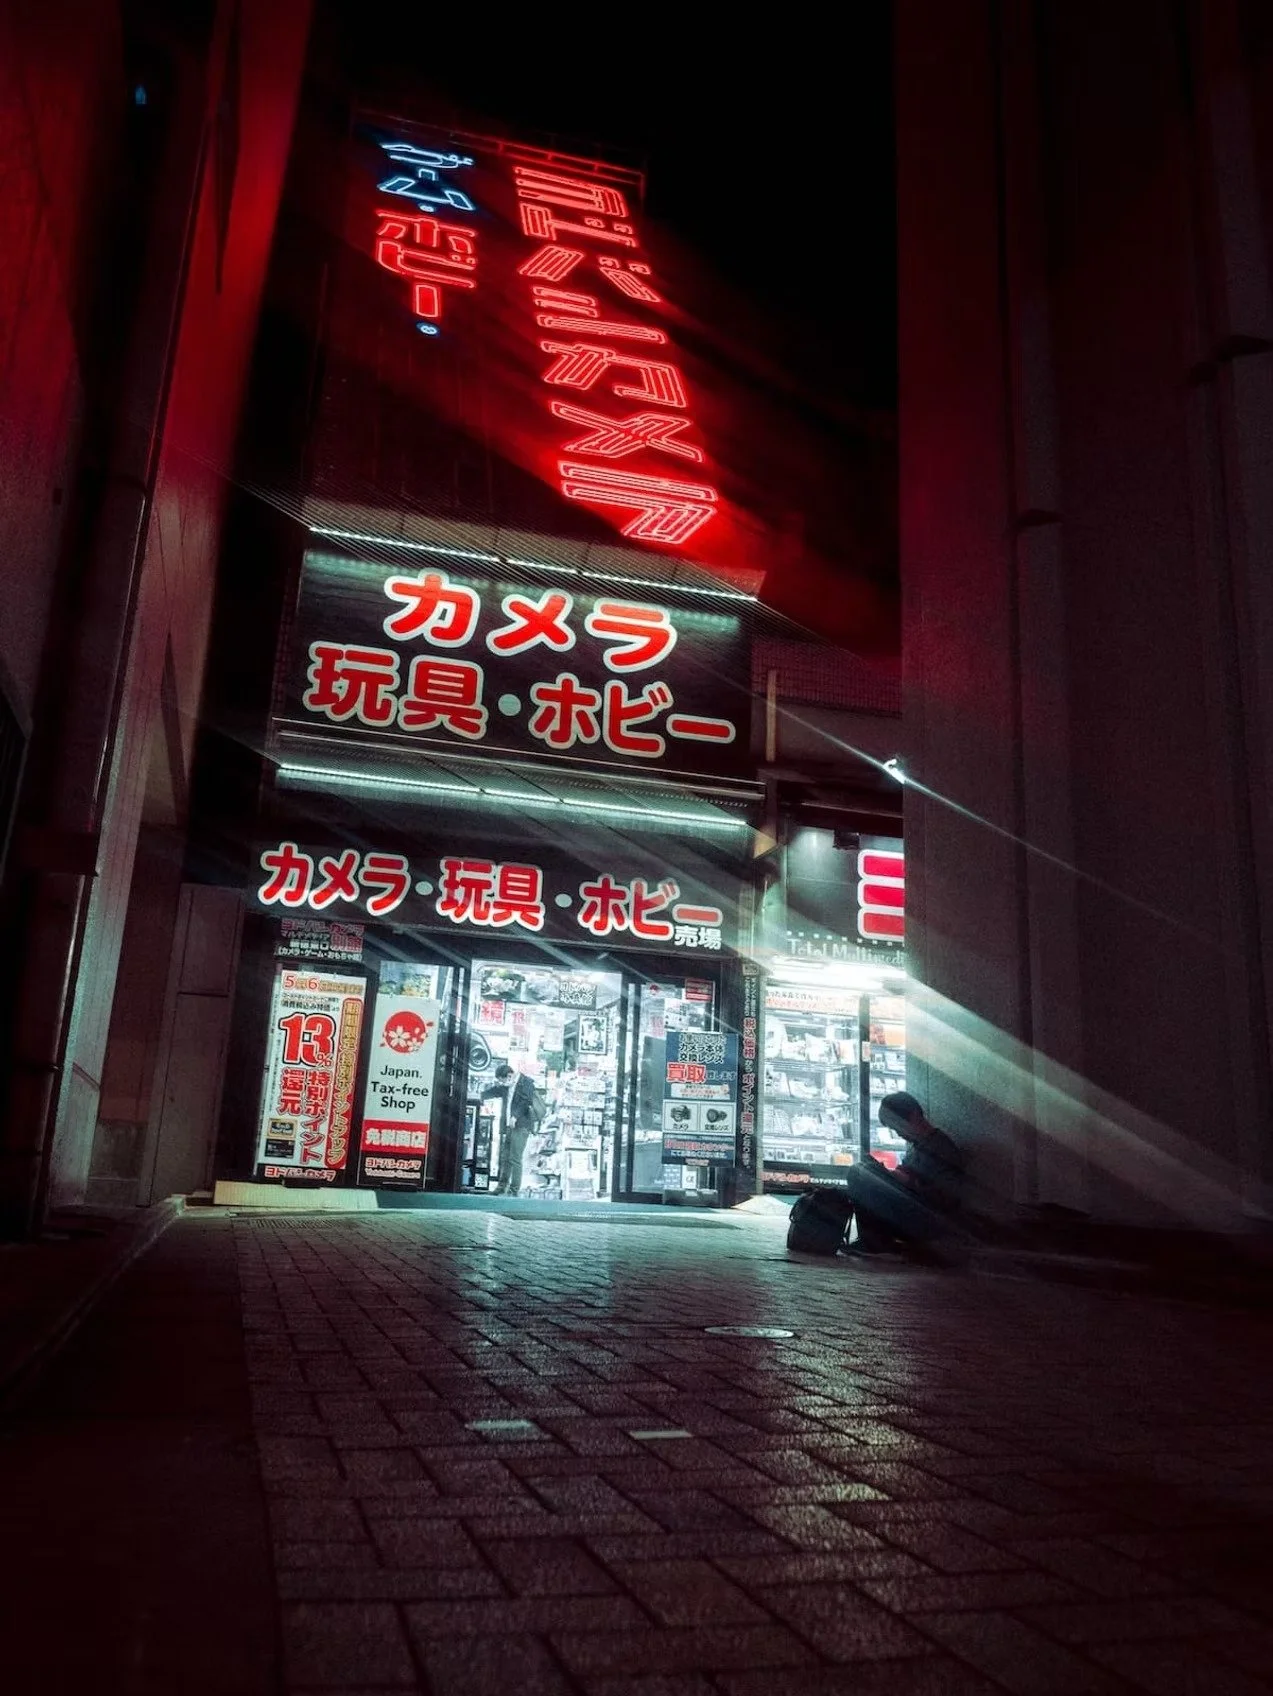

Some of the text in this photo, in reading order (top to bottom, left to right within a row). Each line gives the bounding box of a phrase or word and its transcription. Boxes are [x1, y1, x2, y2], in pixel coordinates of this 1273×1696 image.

[514, 166, 717, 544] ヨドバシカメラ
[383, 568, 677, 673] カメラ
[302, 641, 736, 758] 玩具・ホビー
[371, 1081, 429, 1097] Tax-free
[380, 1065, 422, 1079] Japan.
[298, 1067, 332, 1165] 特別ポイント
[380, 1096, 416, 1113] Shop
[264, 1165, 337, 1182] ヨドバシカメラ
